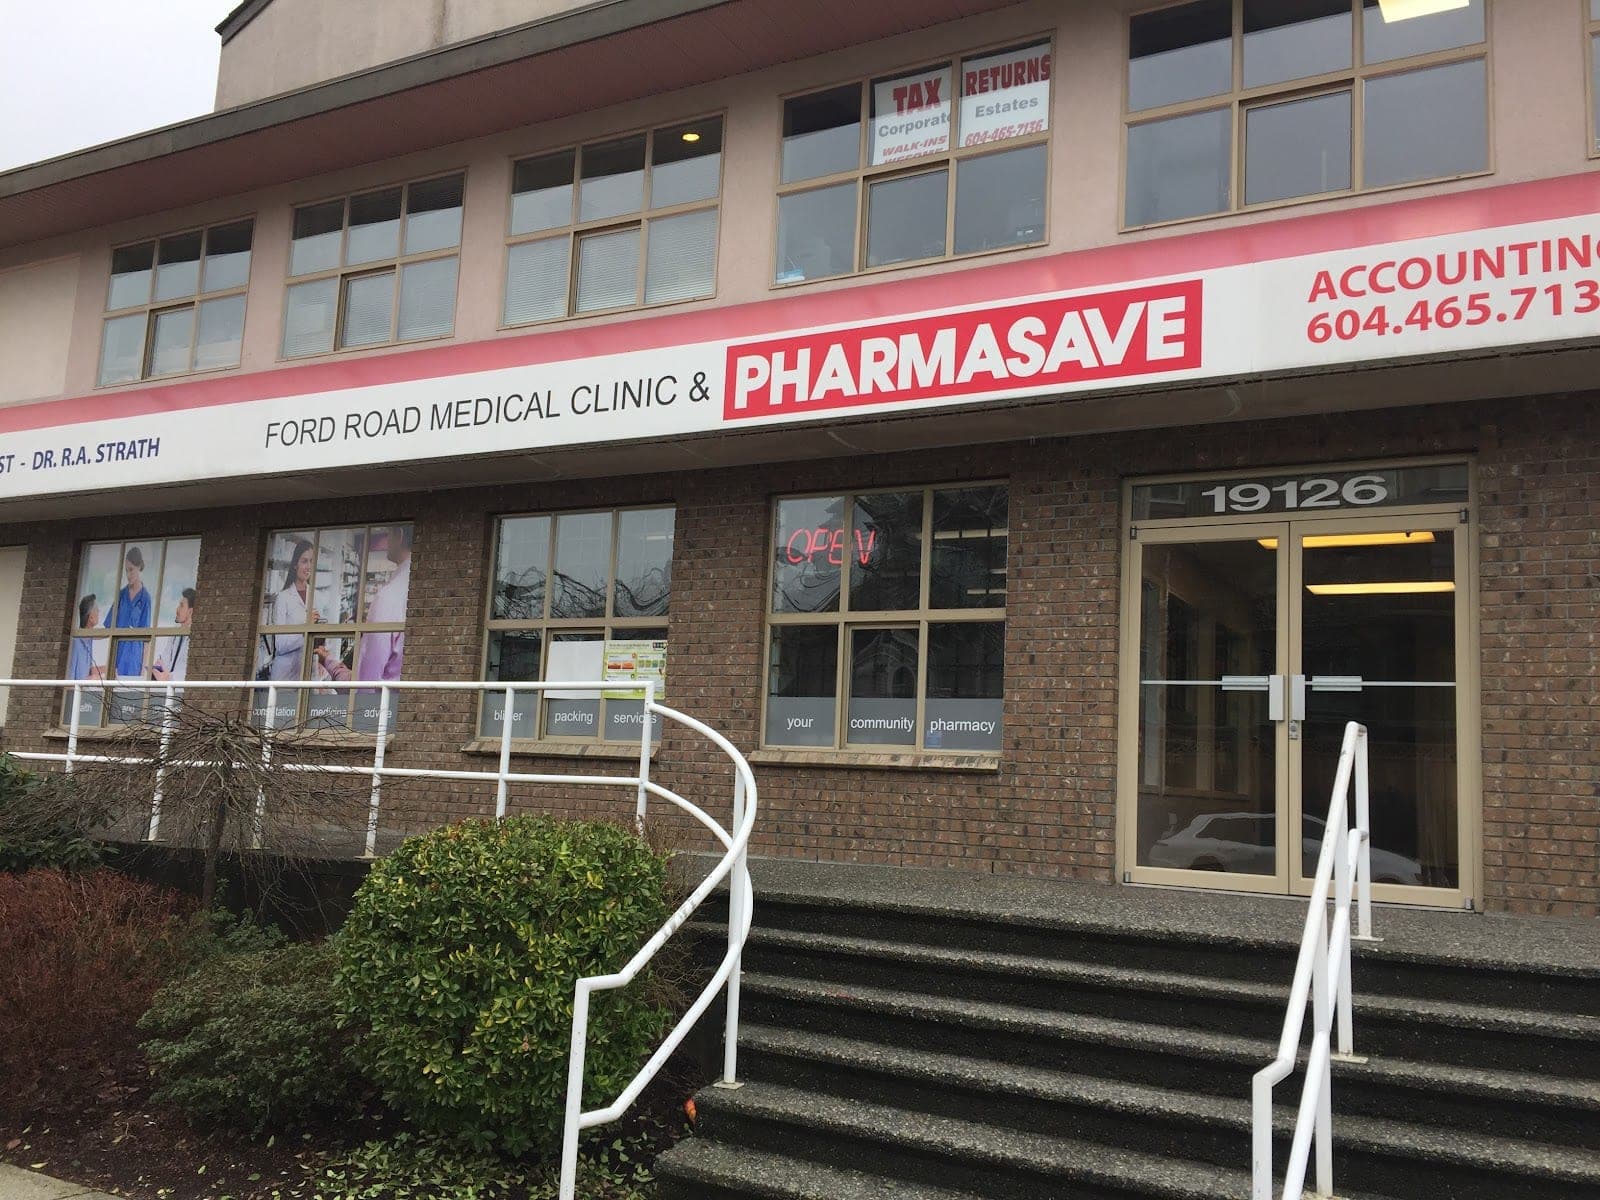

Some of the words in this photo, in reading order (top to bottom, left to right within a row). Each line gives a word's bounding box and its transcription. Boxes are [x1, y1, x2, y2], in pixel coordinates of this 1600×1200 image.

[893, 77, 942, 117] TAX
[965, 54, 1050, 97] RETURNS
[975, 97, 1038, 118] Estates
[882, 134, 947, 156] WALK-INS
[1308, 234, 1600, 303] ACCOUNTIN
[265, 416, 336, 448] FORD
[343, 406, 421, 440] ROAD
[429, 390, 561, 431] MEDICAL
[570, 375, 677, 415] CLINIC
[688, 371, 711, 402] &
[734, 296, 1186, 410] PHARMASAVE
[32, 451, 57, 470] DR.
[61, 446, 91, 467] R.A.
[95, 437, 160, 463] STRATH
[1201, 475, 1388, 512] 19126
[364, 707, 392, 719] adve
[494, 709, 523, 722] blier
[554, 710, 594, 725] packing
[613, 711, 657, 725] servics
[787, 716, 814, 730] your
[850, 716, 915, 733] community
[930, 718, 996, 735] pharmacy
